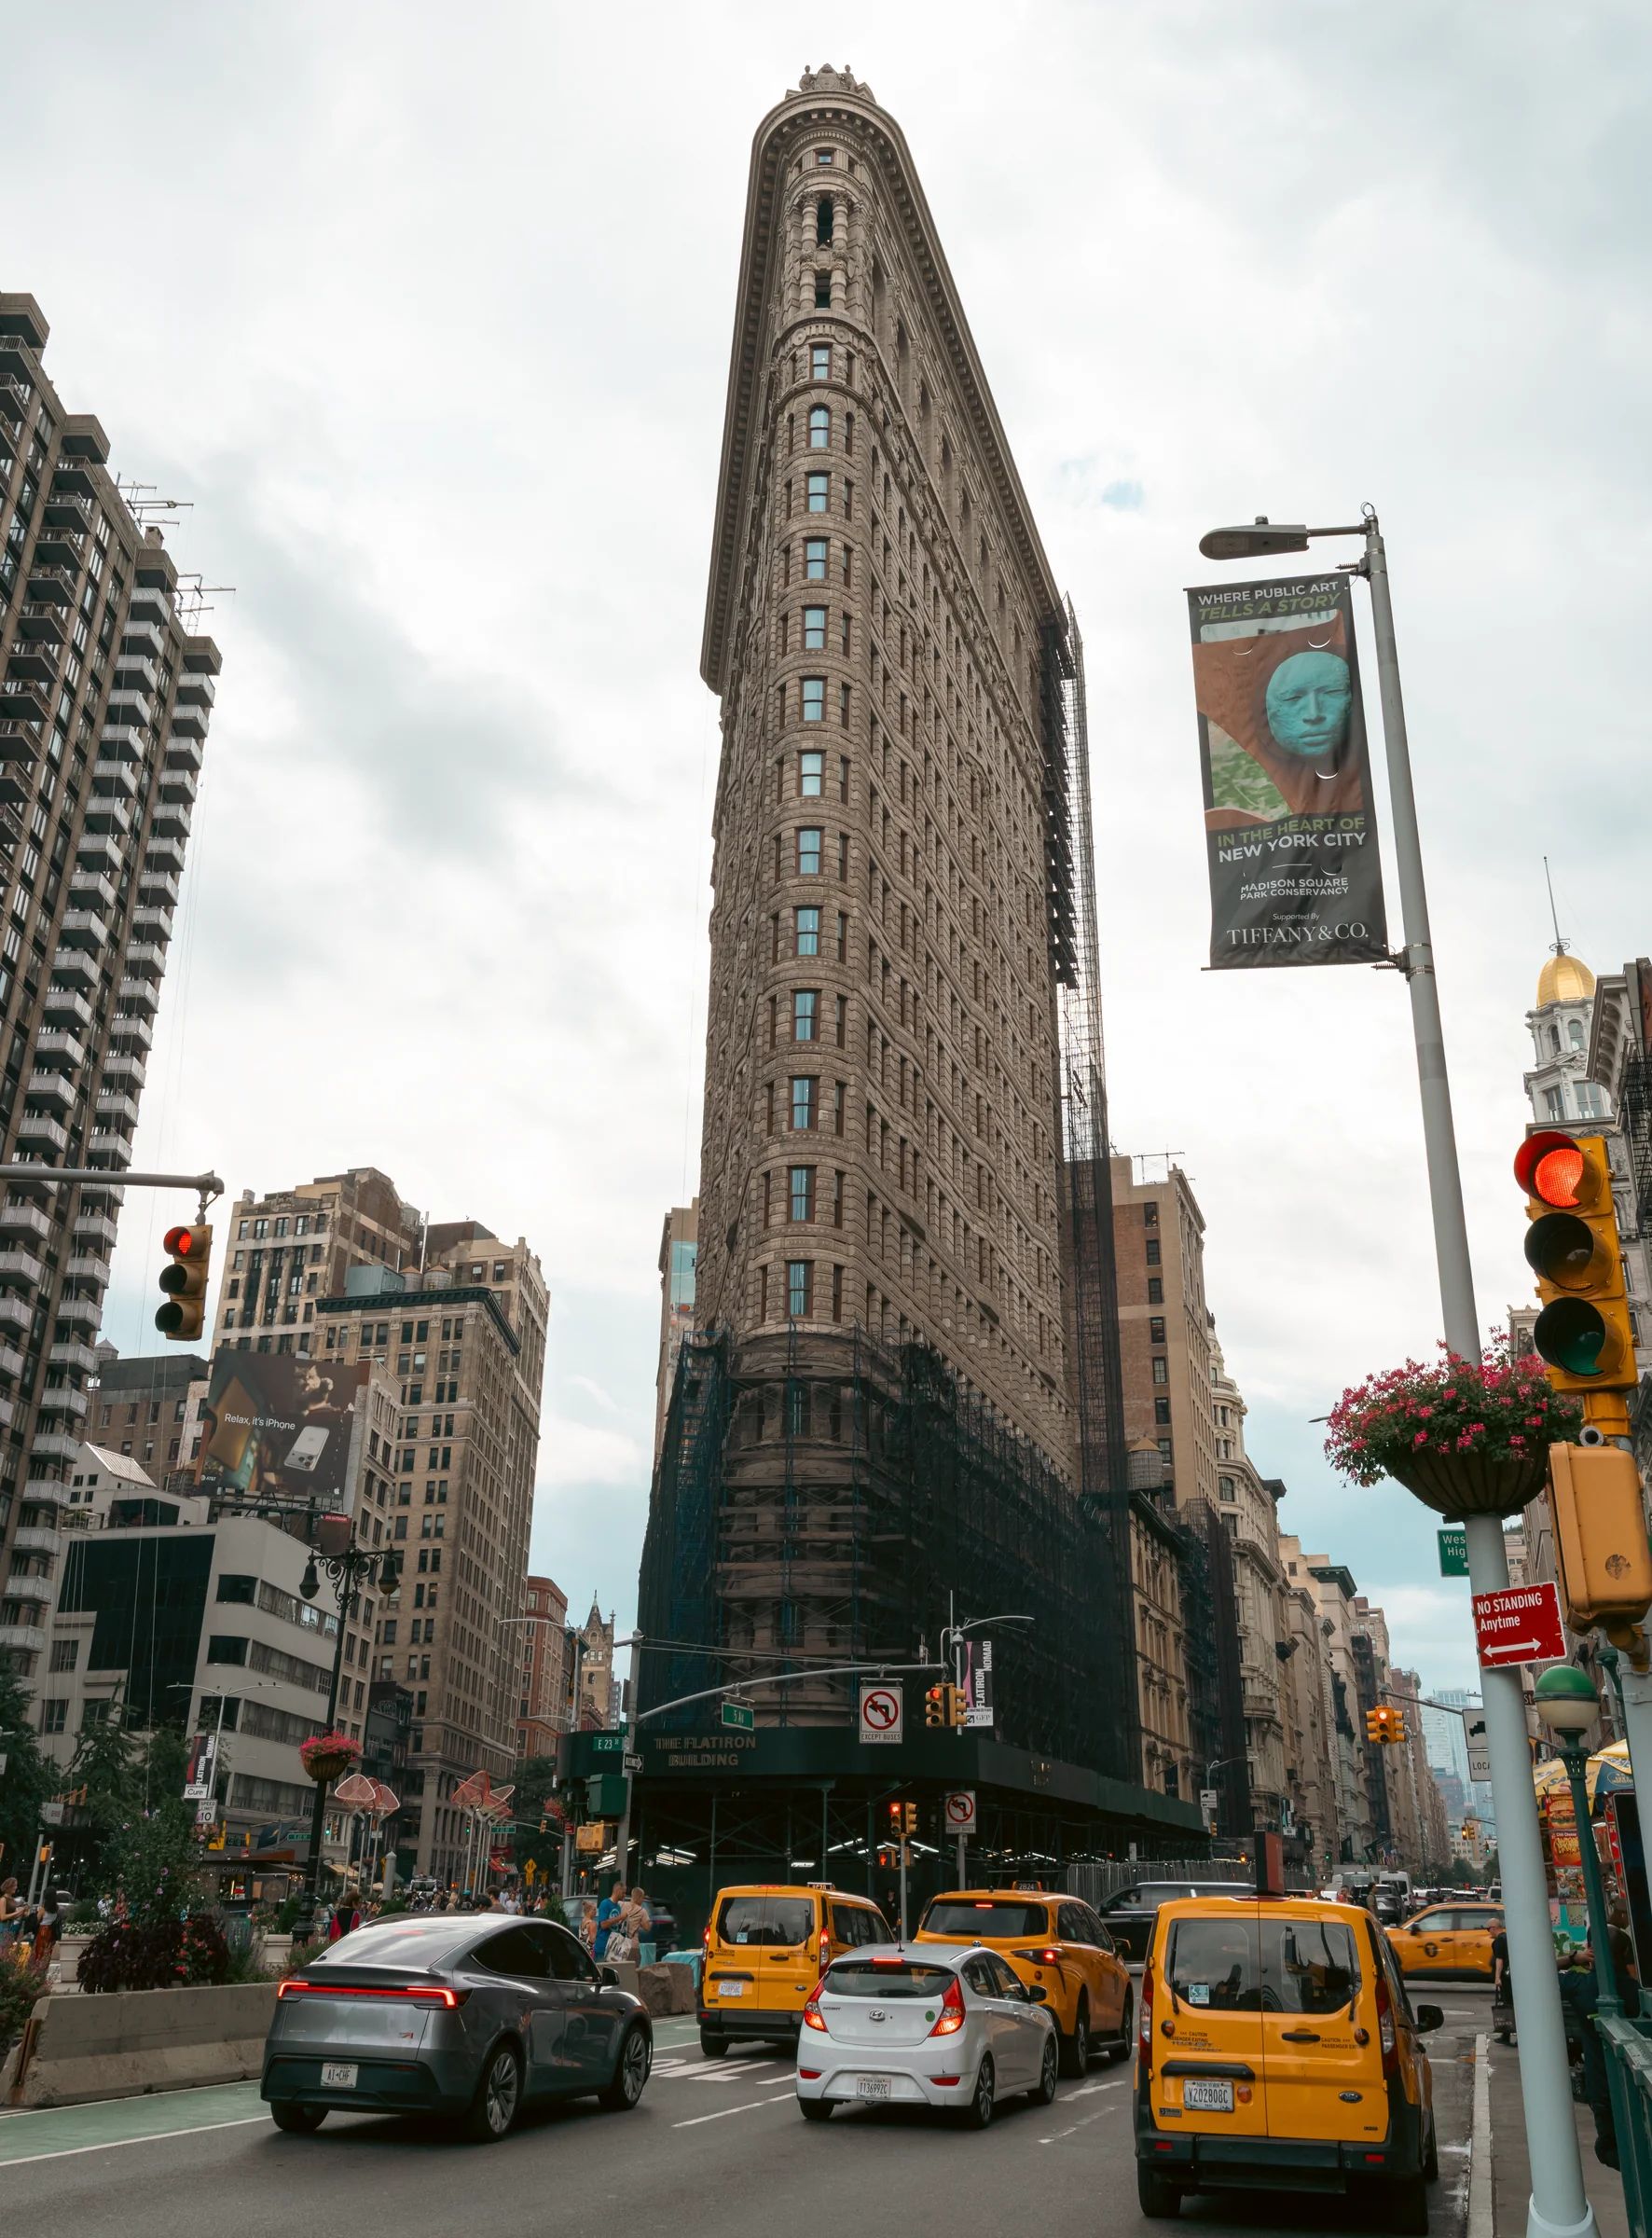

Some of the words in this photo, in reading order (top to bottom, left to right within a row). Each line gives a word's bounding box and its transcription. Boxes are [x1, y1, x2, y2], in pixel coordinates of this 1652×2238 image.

[1198, 590, 1250, 606] WHERE
[1255, 585, 1306, 600] PUBLIC
[1310, 581, 1339, 594] ART
[1198, 603, 1254, 621] TELLS
[1258, 601, 1273, 615] A
[1276, 592, 1341, 613] STORY
[1218, 834, 1235, 848] IN
[1240, 827, 1273, 844] THE
[1277, 818, 1335, 836] HEART
[1340, 817, 1365, 831] OF
[1218, 844, 1262, 863] NEW
[1267, 834, 1319, 851] YORK
[1323, 832, 1367, 847] CITY
[1240, 878, 1295, 894] MADISON
[1299, 877, 1349, 888] SQUARE
[1240, 891, 1268, 901] PARK
[1270, 887, 1349, 897] CONSERVANCY
[1273, 913, 1309, 921] Supported
[1311, 913, 1320, 921] By
[225, 1413, 251, 1426] Relax,
[265, 1417, 296, 1430] iPhone
[1442, 1535, 1466, 1544] Wes
[1477, 1602, 1491, 1615] NO
[1493, 1592, 1543, 1612] STANDING
[1480, 1614, 1521, 1633] Anytime
[983, 1641, 992, 1671] NOMAD
[975, 1668, 984, 1707] FLATIRON
[734, 1709, 737, 1721] 5
[738, 1712, 744, 1723] Av
[206, 1735, 214, 1759] NOMAD
[598, 1739, 601, 1748] E
[604, 1739, 613, 1748] 23
[654, 1737, 681, 1749] THE
[684, 1736, 756, 1749] FLATIRON
[668, 1754, 738, 1766] BUILDING
[1473, 1761, 1490, 1770] LOC
[196, 1756, 206, 1785] FLATIRON
[200, 1813, 212, 1821] 10
[860, 2082, 888, 2094] T136992C
[1188, 2087, 1229, 2104] Y202808C
